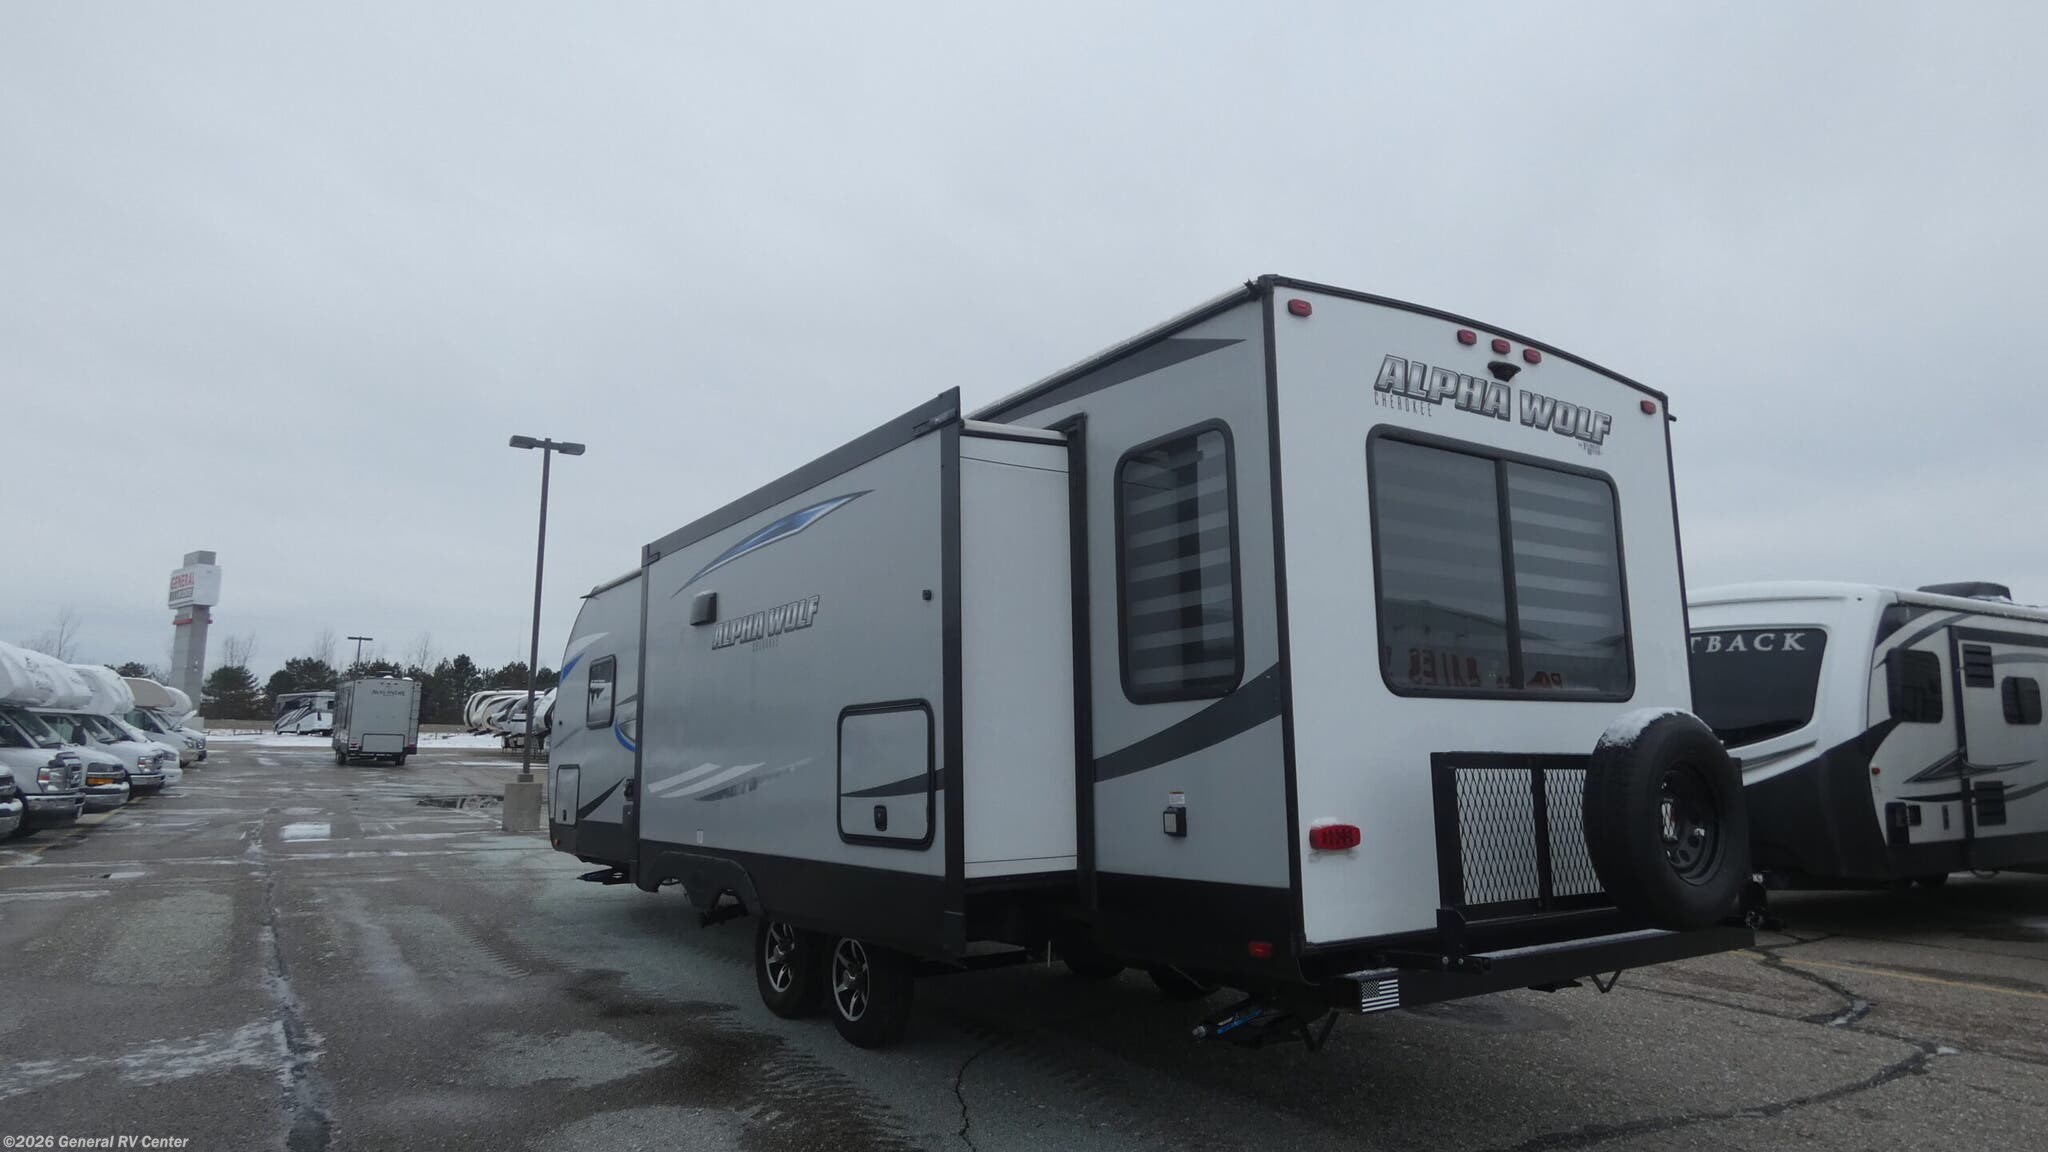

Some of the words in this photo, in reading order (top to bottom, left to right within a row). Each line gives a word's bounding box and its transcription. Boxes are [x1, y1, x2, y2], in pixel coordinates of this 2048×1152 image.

[1373, 353, 1511, 422] ALPHA
[1519, 389, 1612, 446] WOLF
[712, 611, 765, 650] ALPHA
[768, 594, 820, 637] WOLF
